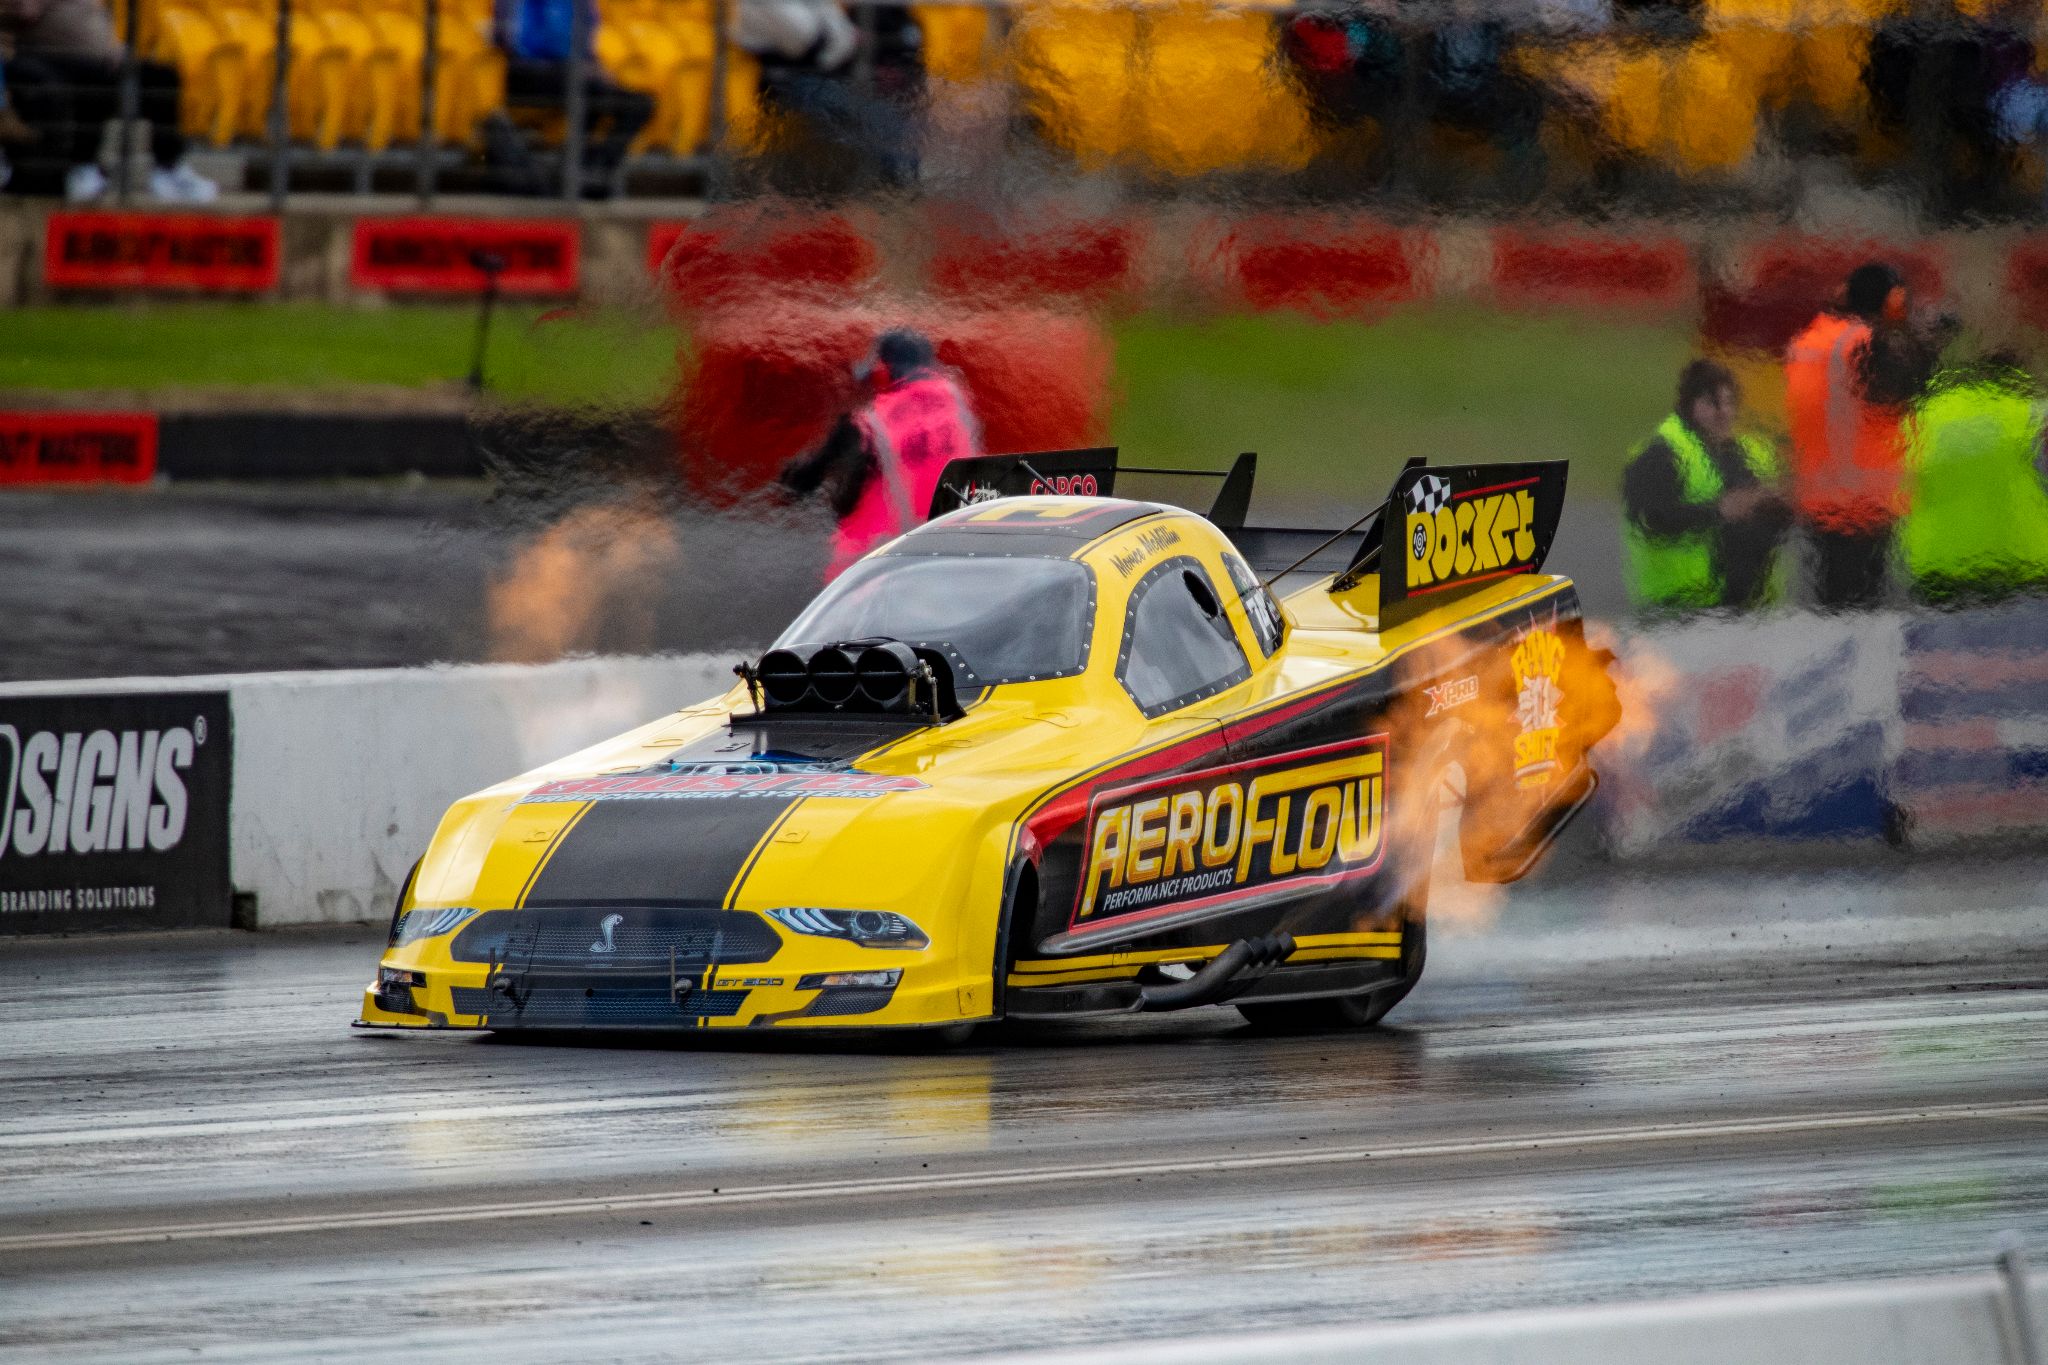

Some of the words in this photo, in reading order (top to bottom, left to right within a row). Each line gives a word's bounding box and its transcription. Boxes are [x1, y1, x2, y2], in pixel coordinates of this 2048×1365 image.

[1080, 751, 1384, 916] AEROFLOW
[0, 890, 72, 912] BRANDING
[77, 886, 156, 909] SOLUTIONS
[1102, 882, 1182, 912] PERFORMANCE
[1181, 867, 1234, 896] PRODUCTS
